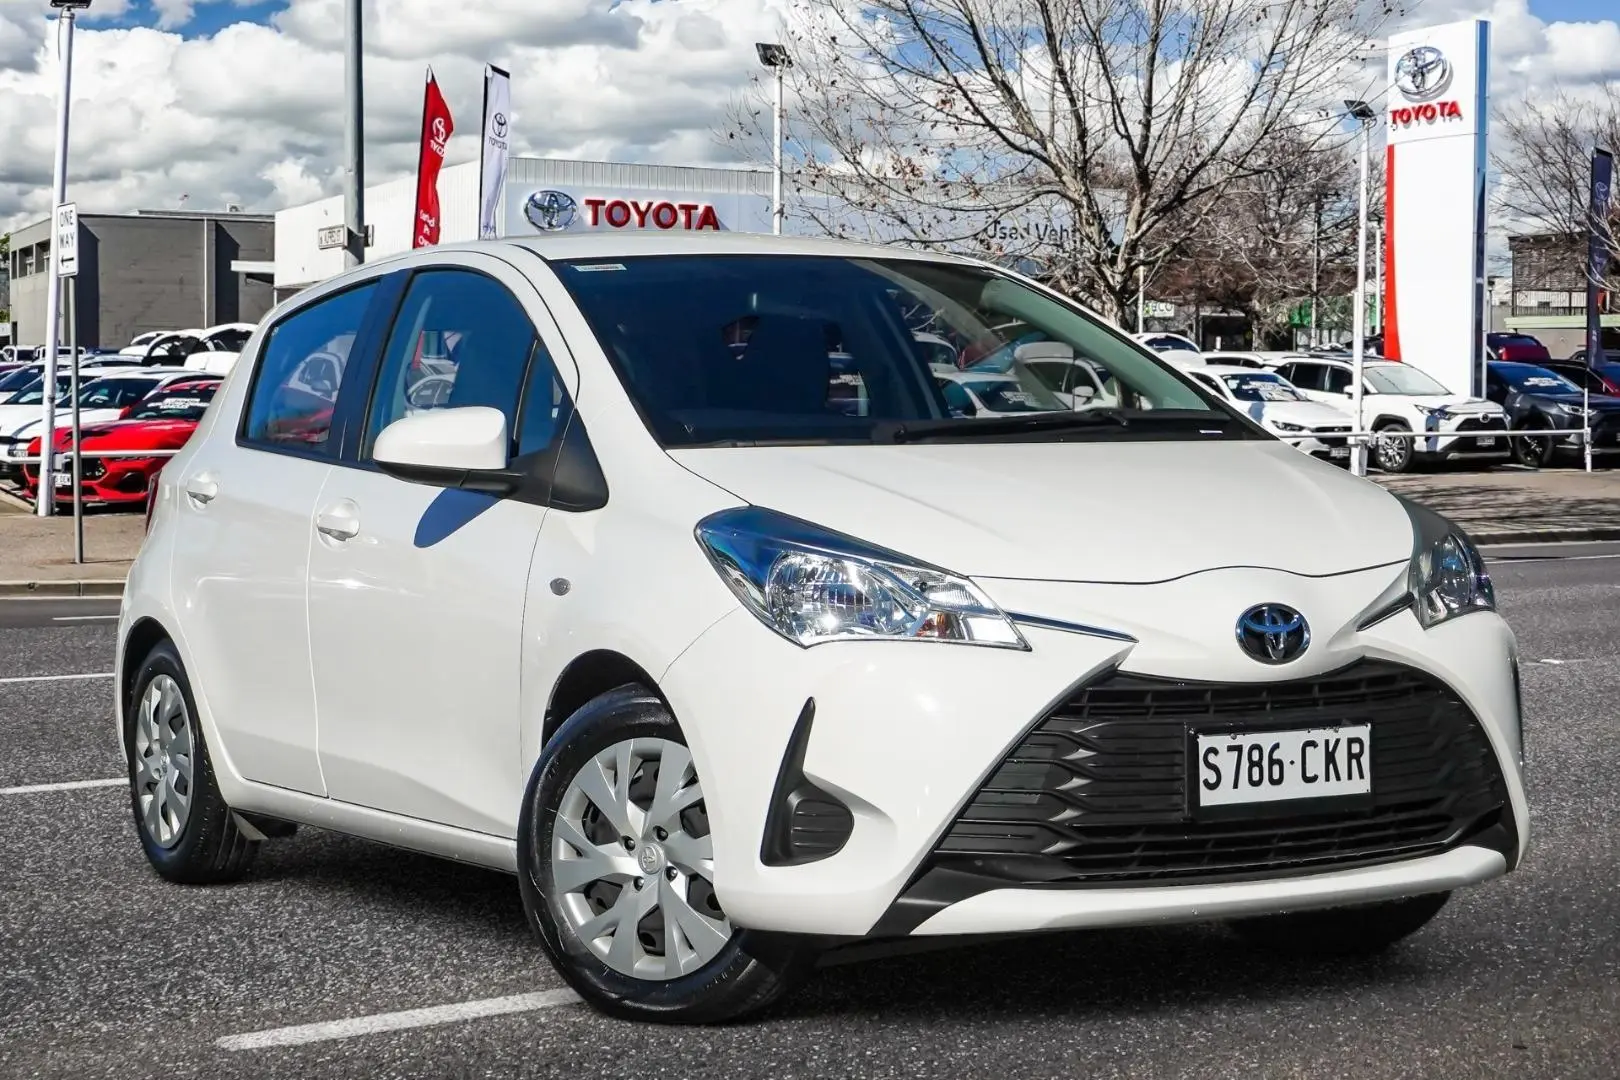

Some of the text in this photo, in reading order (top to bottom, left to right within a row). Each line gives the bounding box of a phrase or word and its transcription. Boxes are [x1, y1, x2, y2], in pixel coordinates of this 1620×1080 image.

[1390, 101, 1462, 125] TOYOTA
[60, 210, 74, 227] ONE
[585, 199, 720, 231] TOYOTA
[60, 232, 75, 248] WAY
